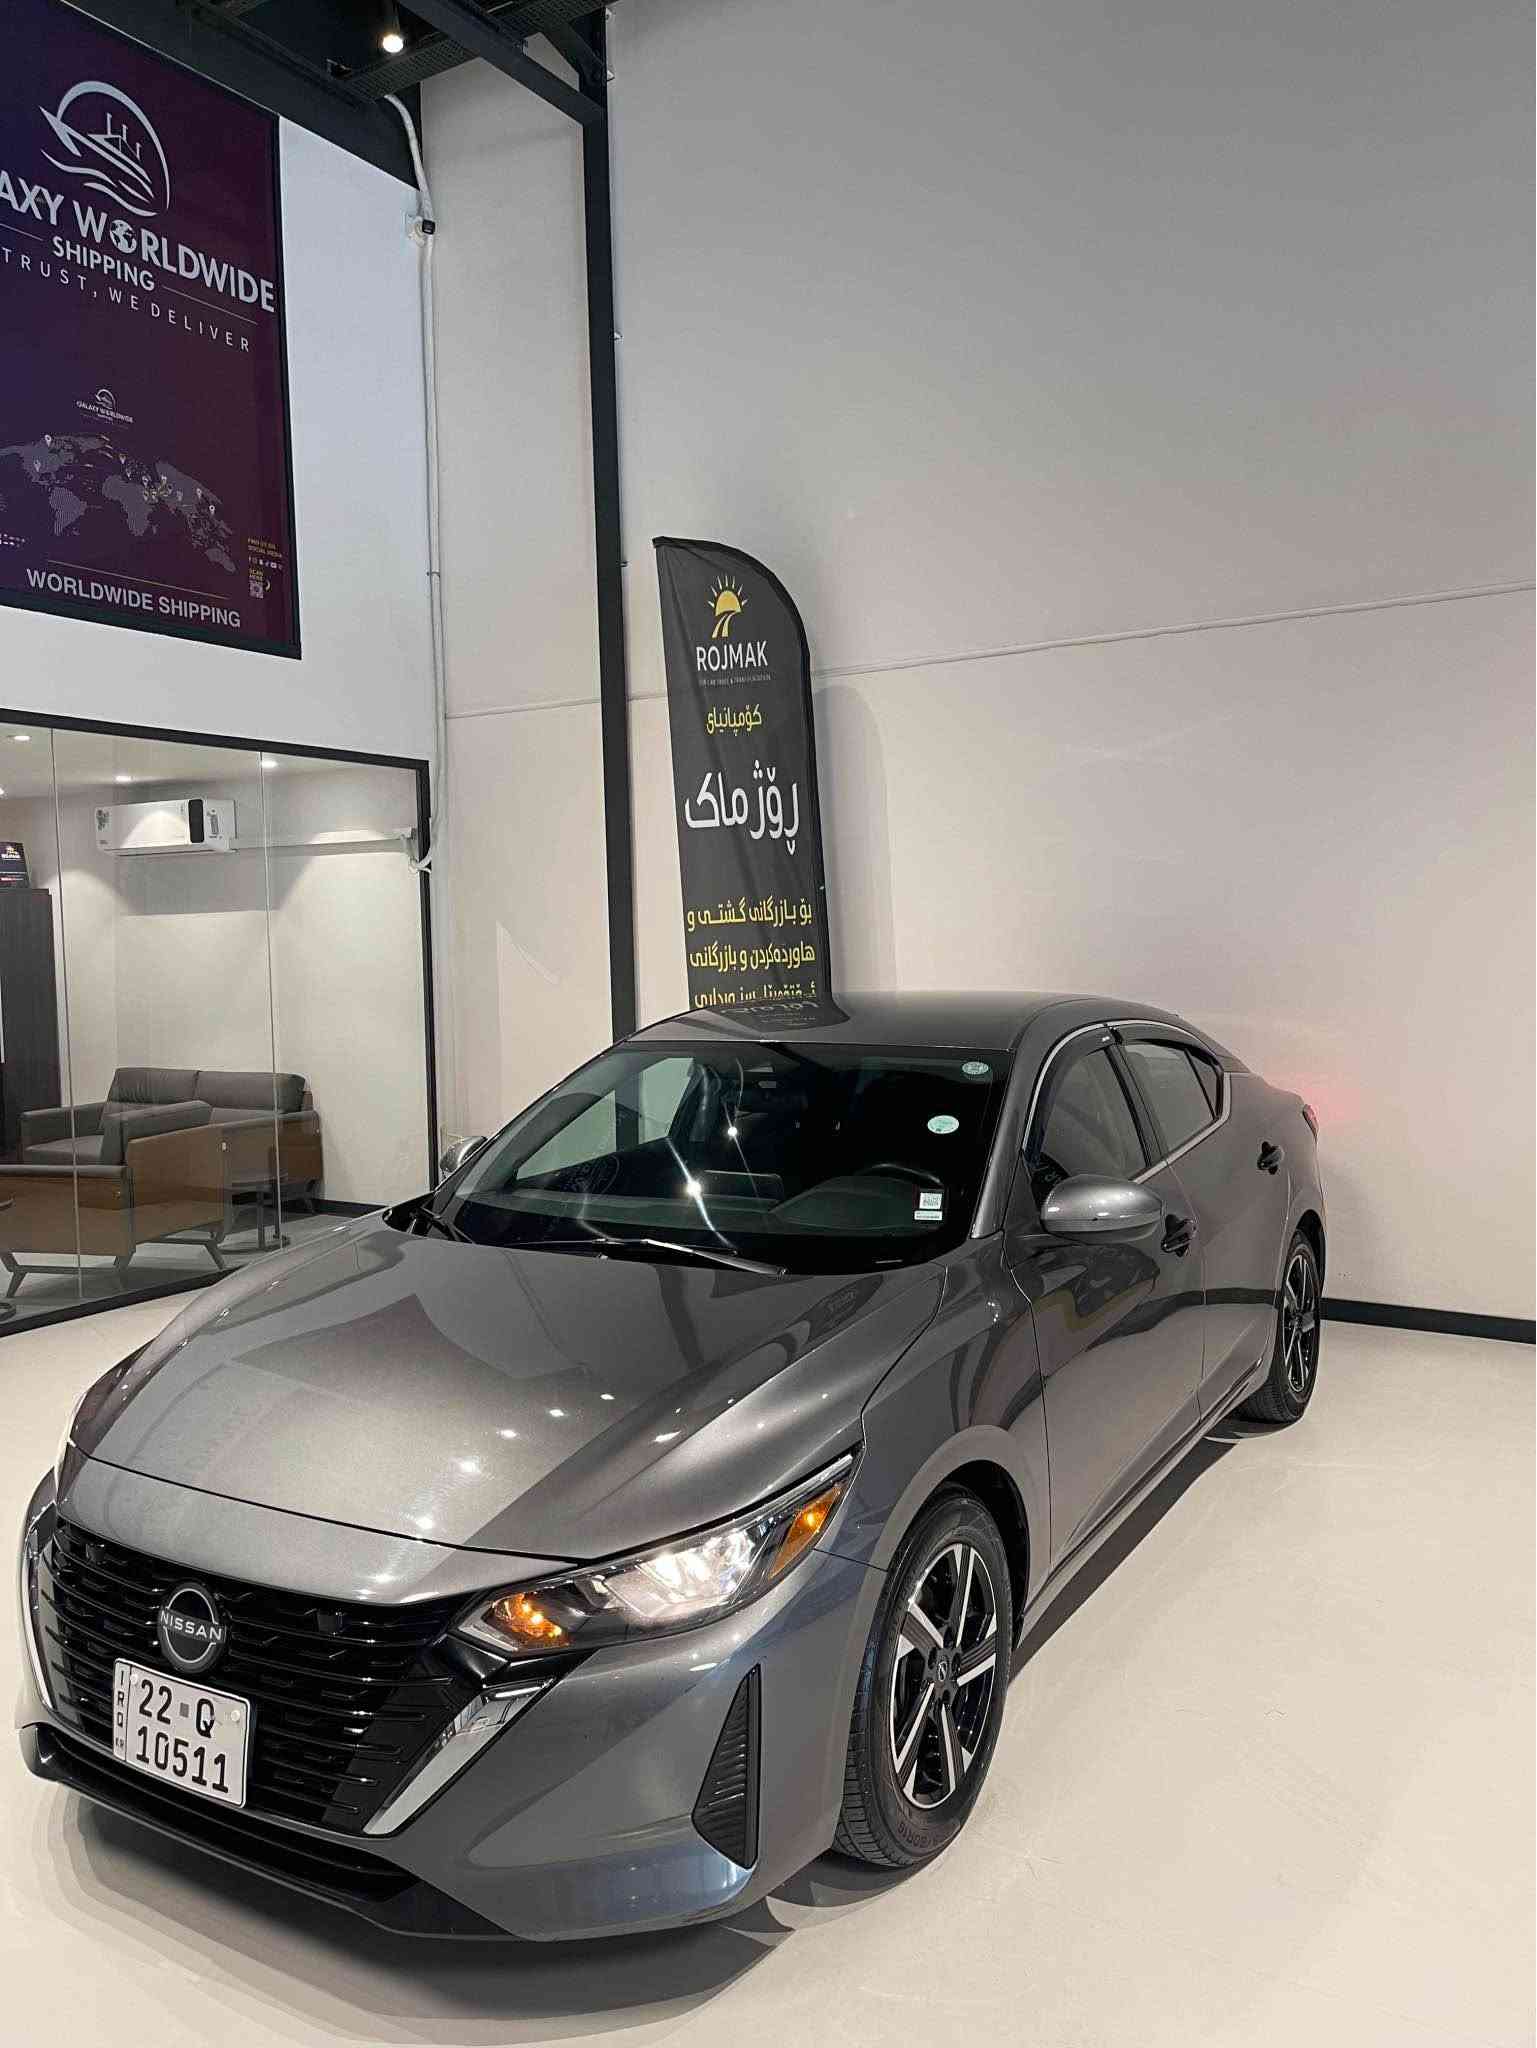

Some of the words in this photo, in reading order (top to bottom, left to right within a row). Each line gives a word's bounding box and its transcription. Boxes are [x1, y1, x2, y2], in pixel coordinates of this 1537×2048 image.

[52, 235, 155, 291] SHIPPING
[72, 200, 276, 312] WORLDWIDE
[1, 246, 97, 298] TRUST,
[108, 286, 139, 311] WE
[150, 303, 250, 353] DELIVER
[26, 568, 154, 612] WORLDWIDE
[158, 596, 241, 628] SHIPPING
[695, 640, 769, 672] ROJMAK
[687, 910, 696, 932] و
[799, 898, 812, 926] بۆ
[740, 950, 748, 972] و
[160, 1609, 223, 1641] NISSAN
[138, 1678, 173, 1725] 22
[195, 1697, 216, 1739] Q
[135, 1725, 229, 1794] 10511
